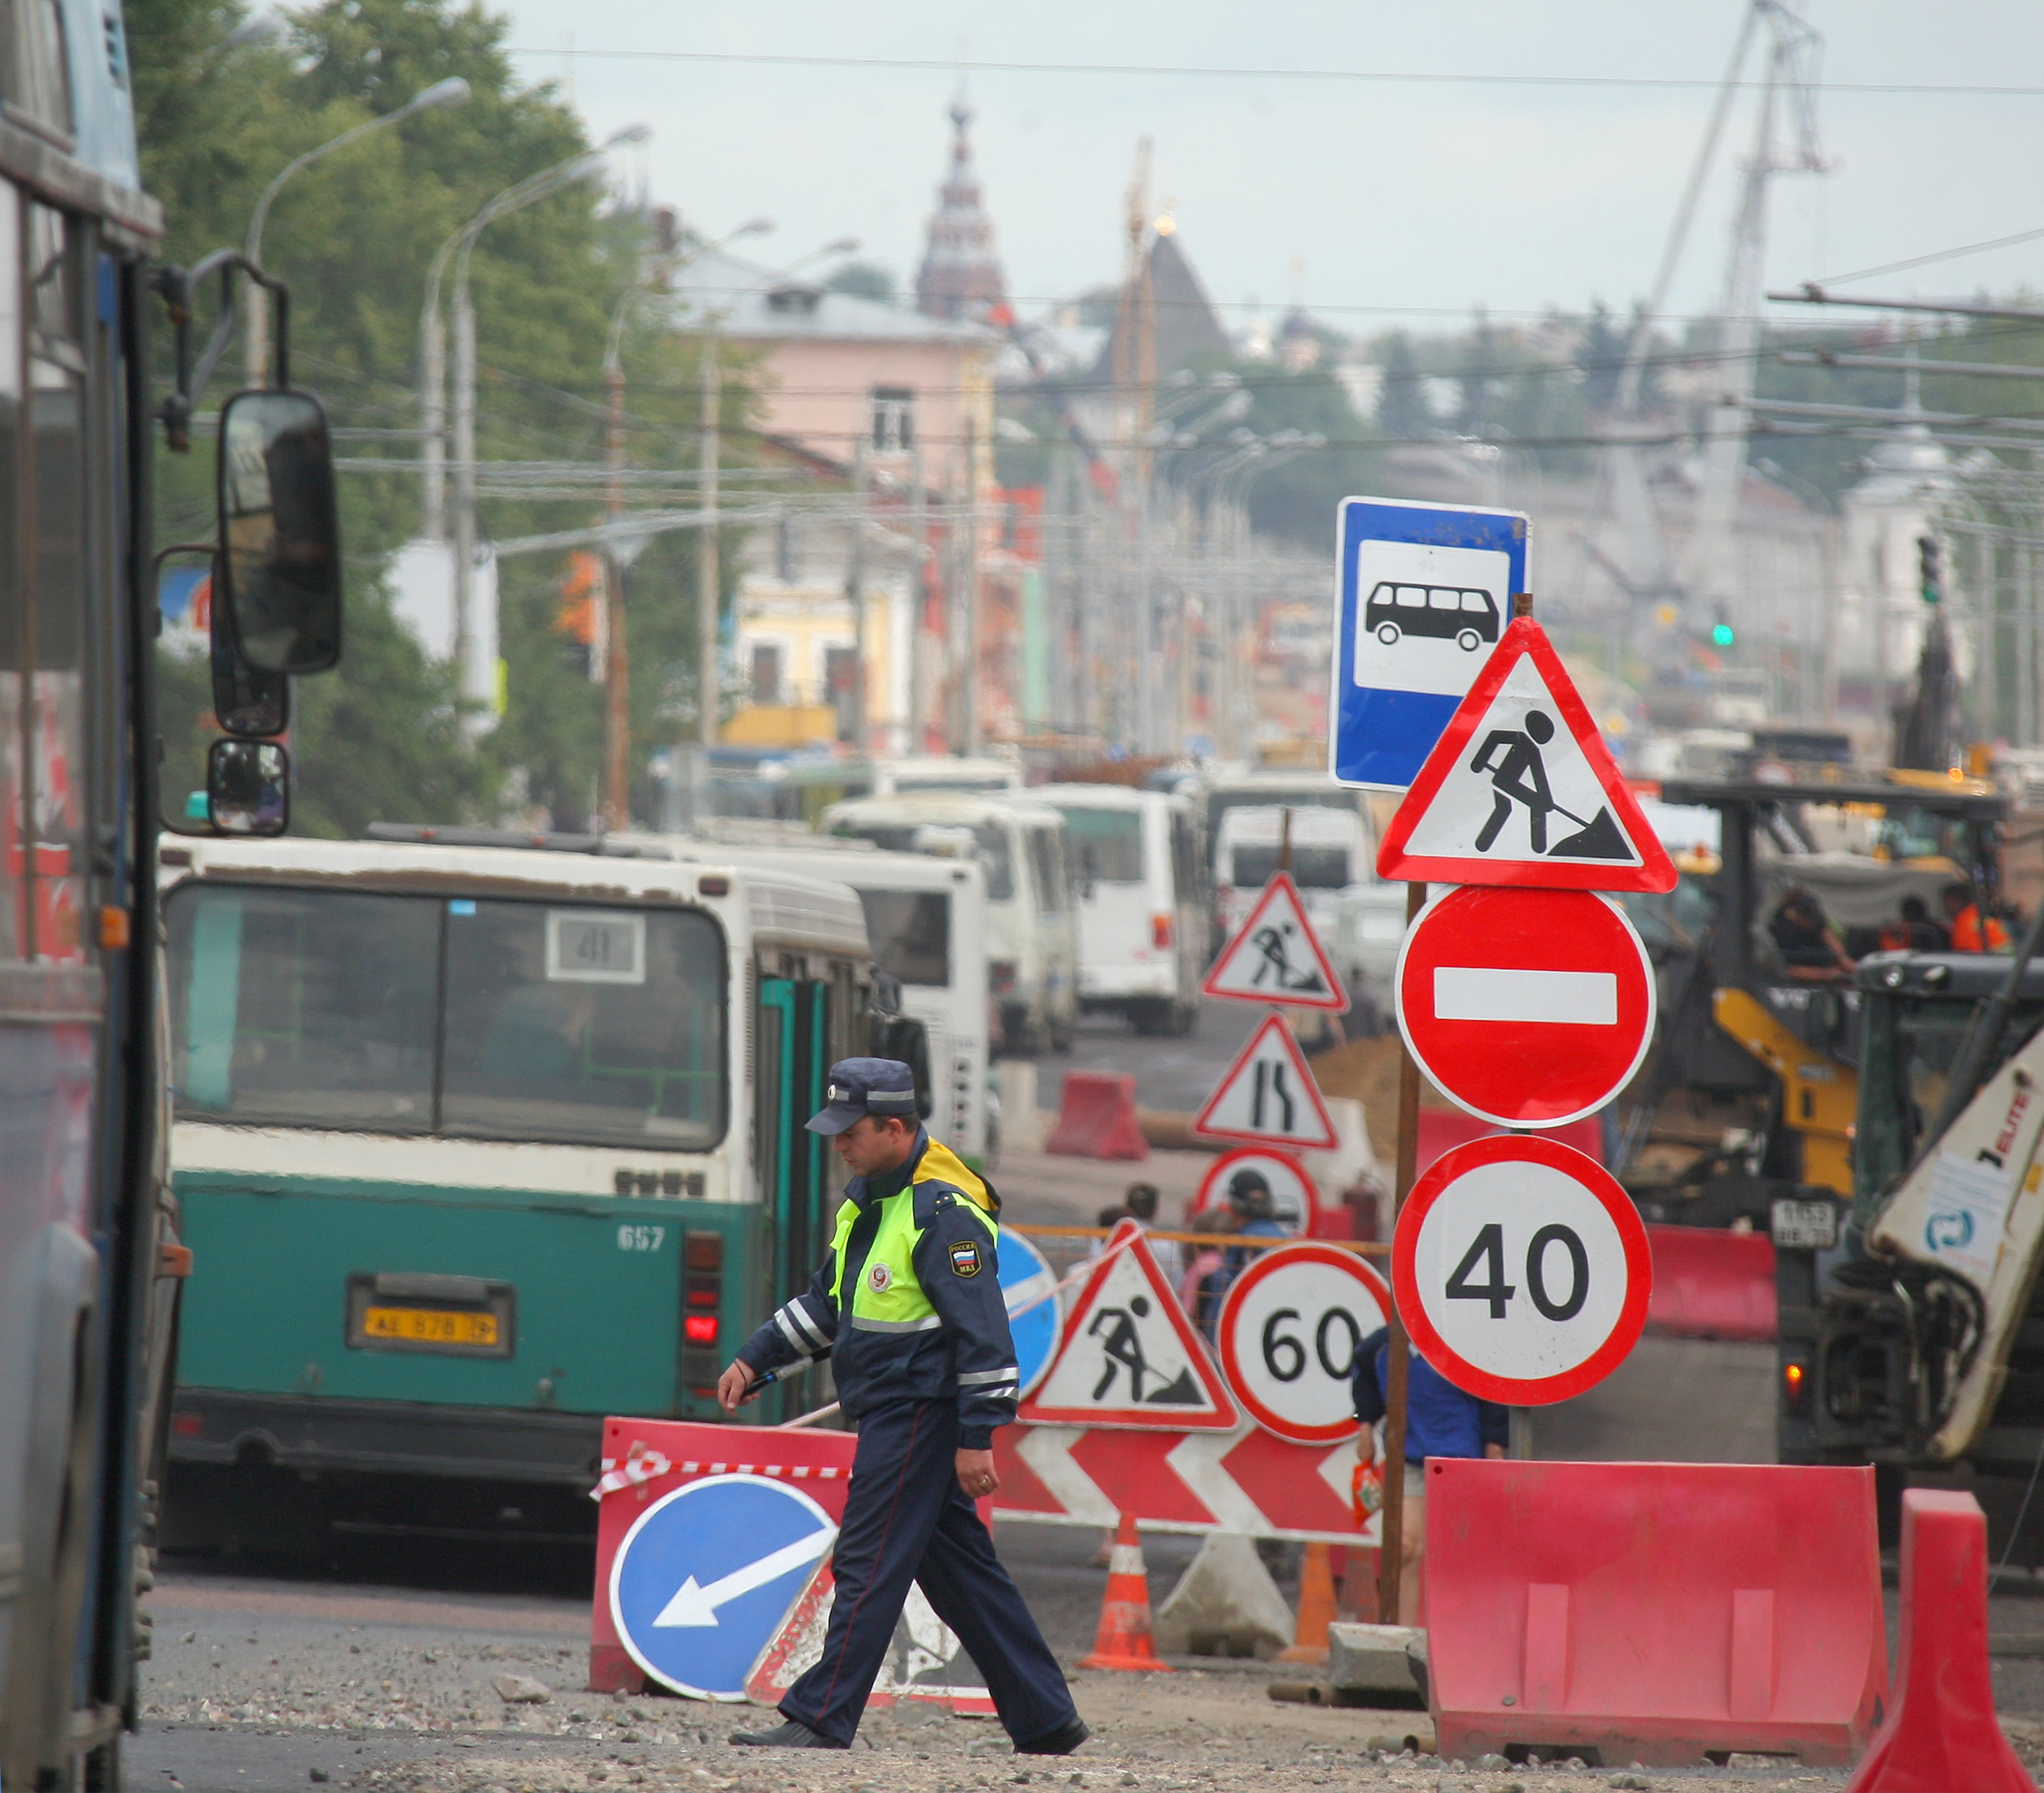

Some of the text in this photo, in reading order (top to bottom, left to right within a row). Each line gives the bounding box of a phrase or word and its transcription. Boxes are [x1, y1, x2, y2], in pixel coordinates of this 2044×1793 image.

[617, 1225, 665, 1252] 657
[951, 1243, 976, 1252] РОССИЯ
[959, 1264, 975, 1273] МВД
[1445, 1223, 1590, 1322] 40
[1262, 1307, 1362, 1382] 60
